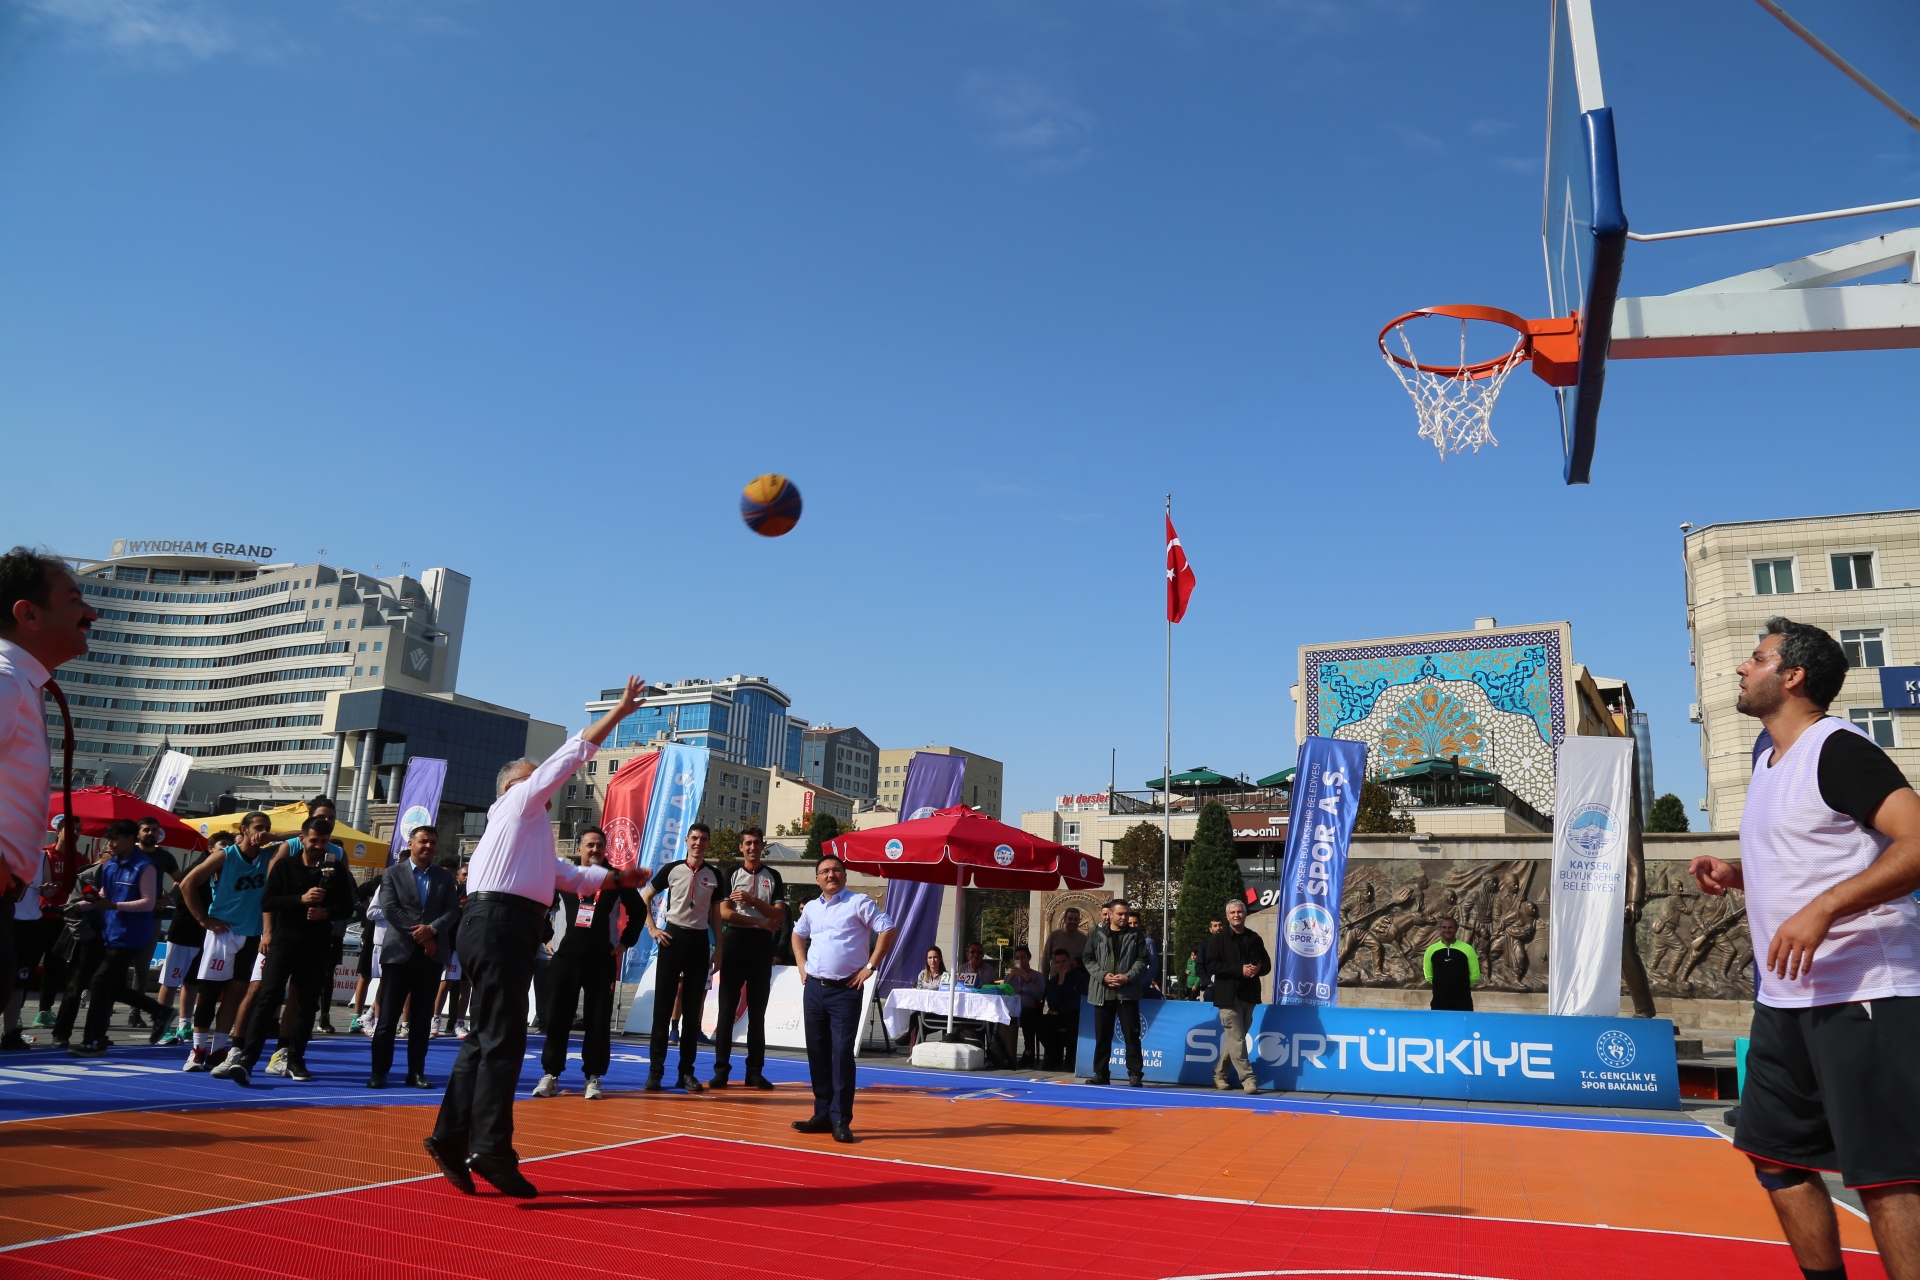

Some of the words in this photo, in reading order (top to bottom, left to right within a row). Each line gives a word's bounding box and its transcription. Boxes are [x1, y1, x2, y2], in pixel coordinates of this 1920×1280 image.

[129, 540, 208, 553] WYNDHAM
[212, 542, 274, 558] GRAND
[1307, 762, 1321, 808] BELEDİYESİ
[1318, 766, 1348, 816] A.Ş.
[1299, 809, 1314, 859] BÜYÜKŞEHİR
[1307, 824, 1336, 896] SPOR
[1295, 860, 1307, 894] KAYSERİ
[1560, 868, 1621, 882] BÜYÜKŞEHİR
[1289, 934, 1312, 943] SPOR
[210, 958, 225, 971] 10
[334, 967, 350, 977] ÇLİK
[964, 974, 975, 985] 21
[1151, 1050, 1163, 1058] VE
[1580, 1071, 1598, 1079] T.C.
[1600, 1071, 1642, 1083] GENÇLİK
[1643, 1073, 1657, 1082] VE
[1581, 1081, 1606, 1090] SPOR
[1607, 1082, 1658, 1092] BAKANLIĞI
